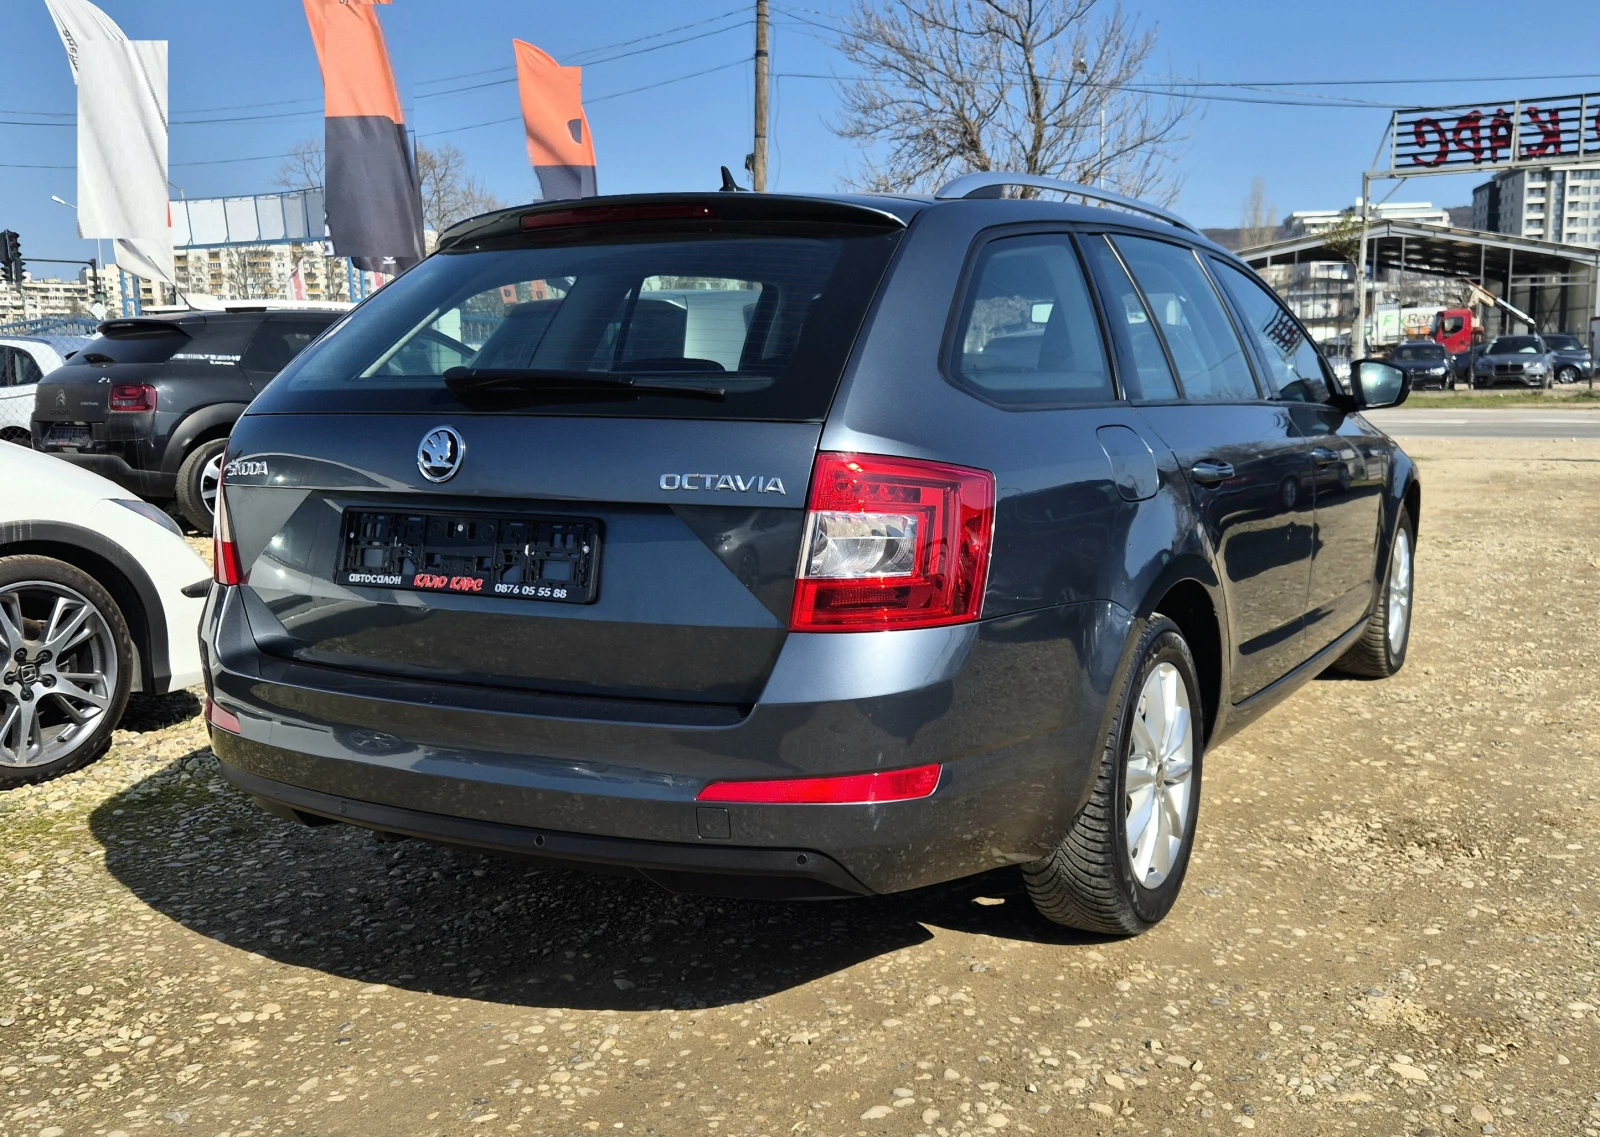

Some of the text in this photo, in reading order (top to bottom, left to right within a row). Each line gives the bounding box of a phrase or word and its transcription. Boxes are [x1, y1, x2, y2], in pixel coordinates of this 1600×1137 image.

[659, 472, 787, 495] OCTAVIA
[348, 573, 568, 599] автосалон КАЛО КАРС 0876 05 55 88
